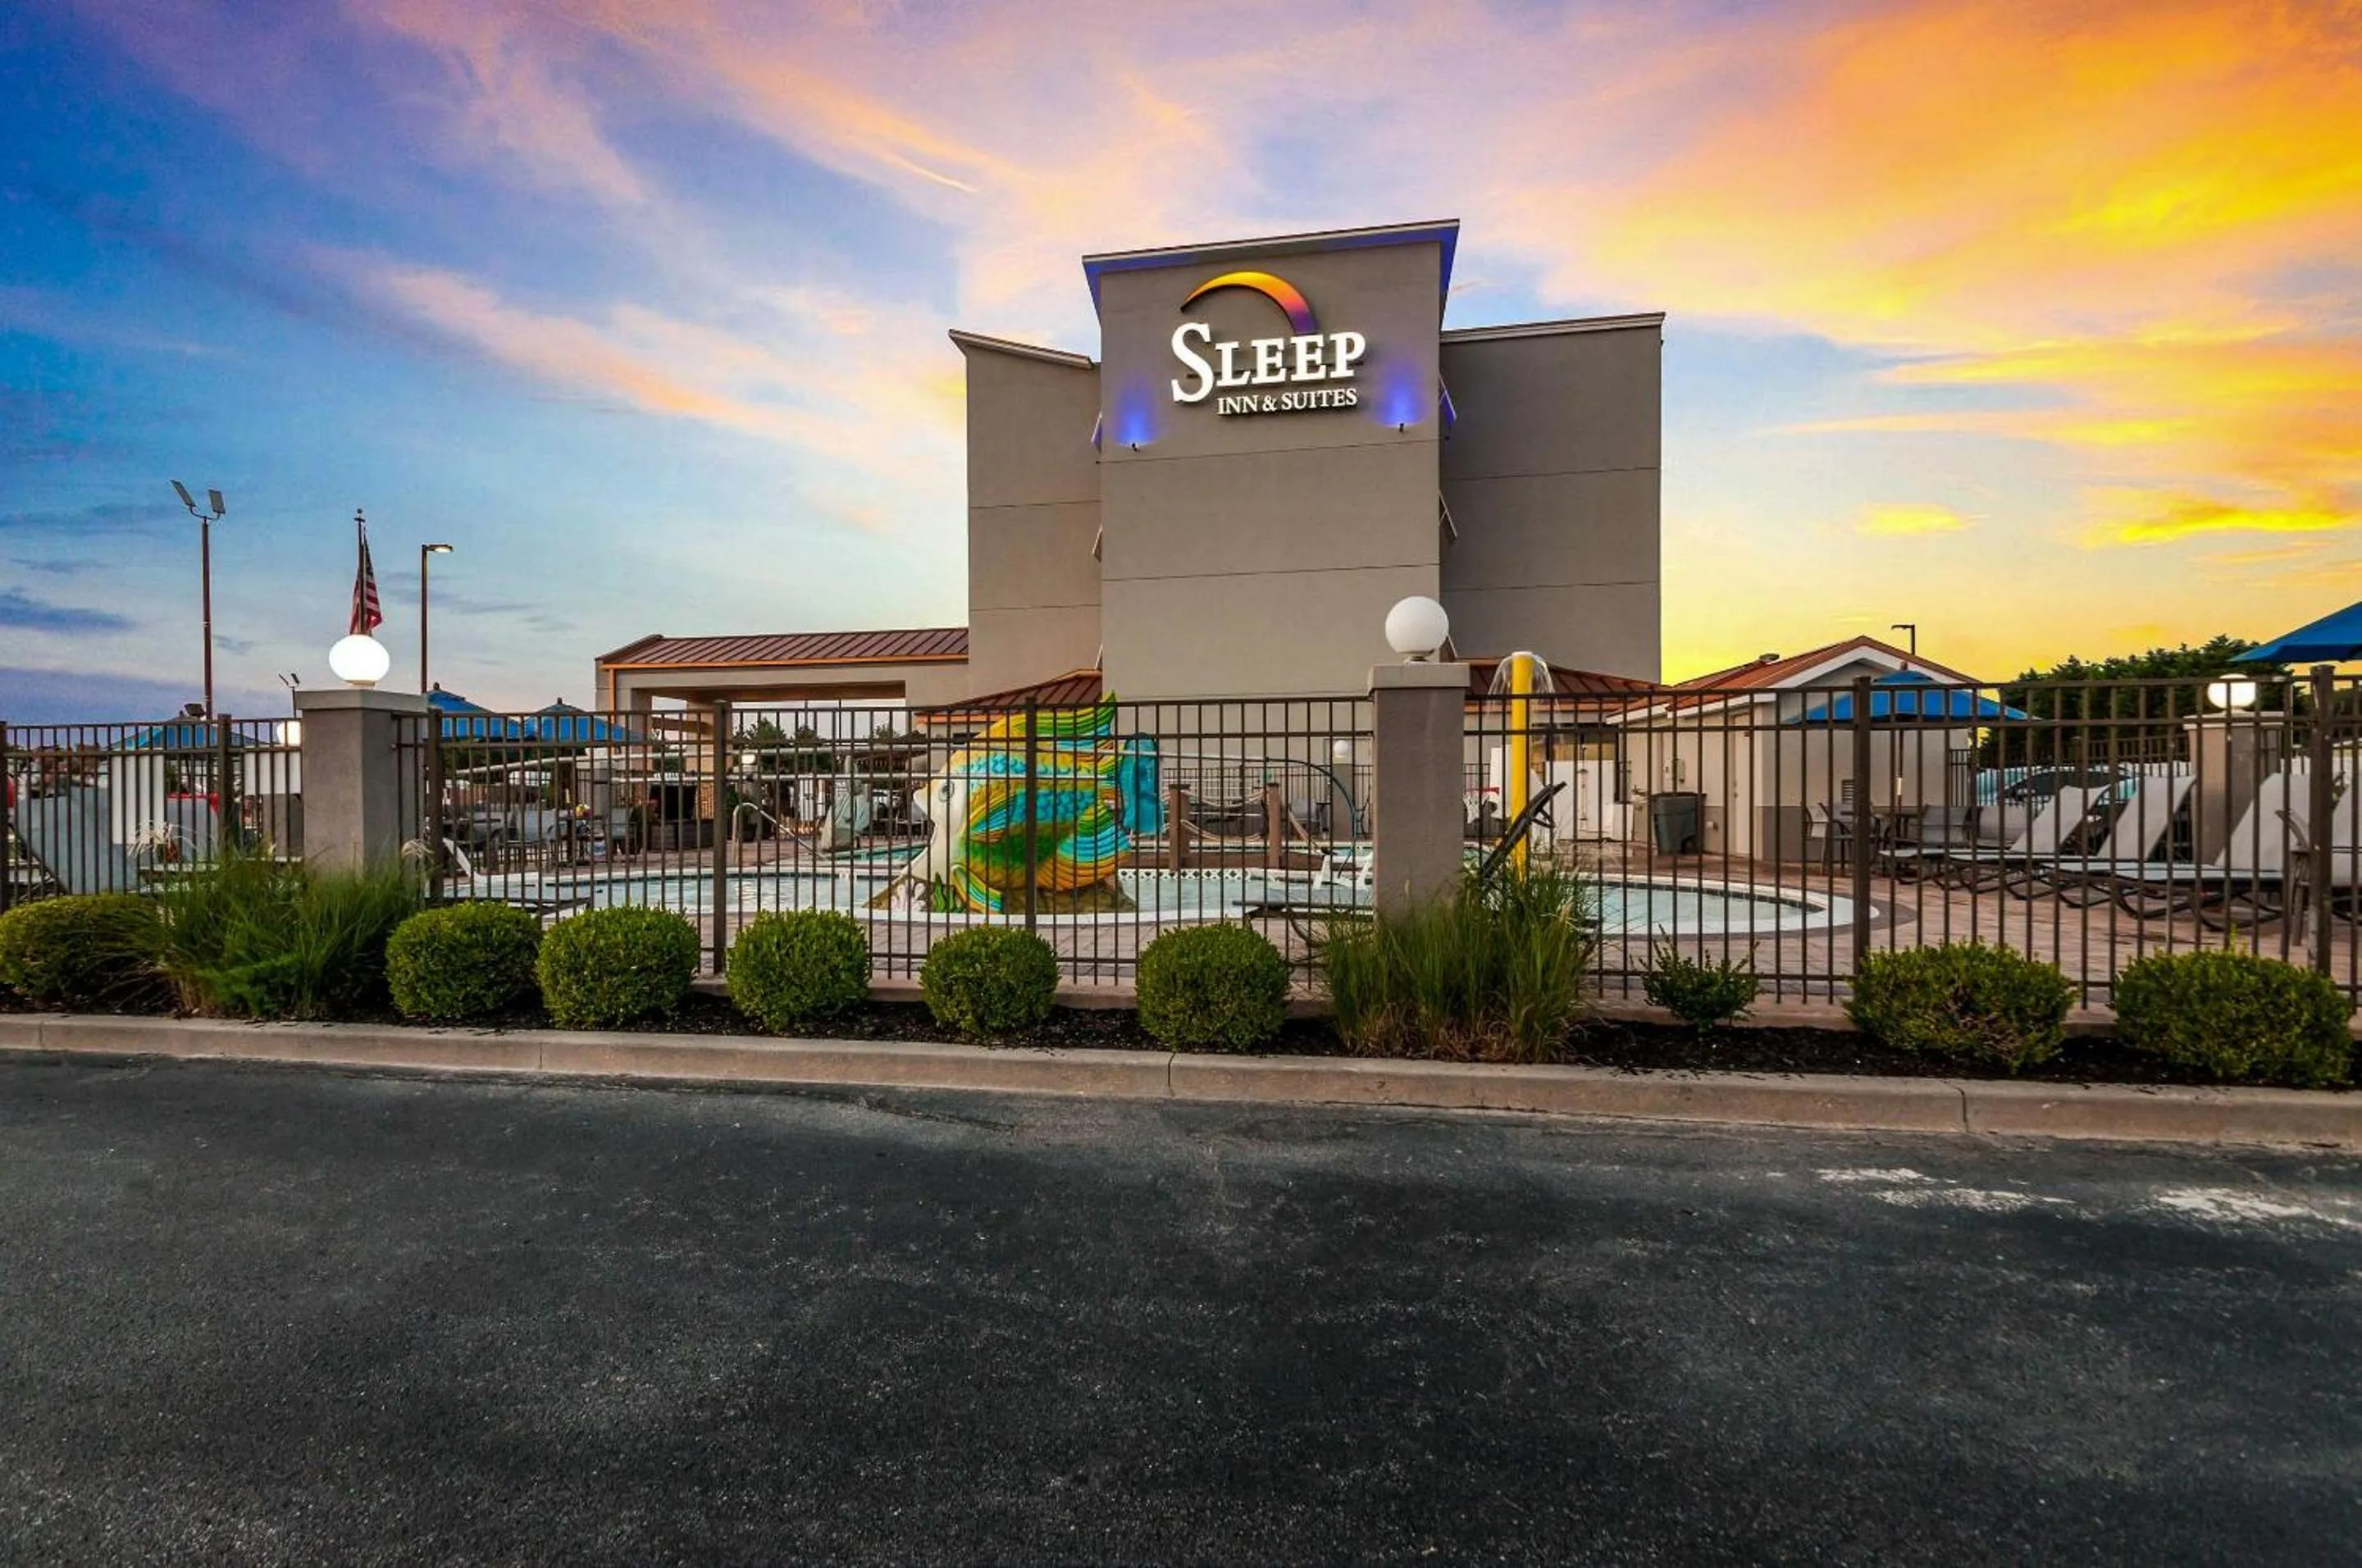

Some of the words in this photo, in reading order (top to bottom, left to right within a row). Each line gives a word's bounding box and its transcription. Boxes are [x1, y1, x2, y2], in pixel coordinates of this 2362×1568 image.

[1171, 322, 1366, 402] SLEEP
[1218, 395, 1259, 415] INN
[1262, 395, 1277, 412] &
[1281, 389, 1357, 410] SUITES
